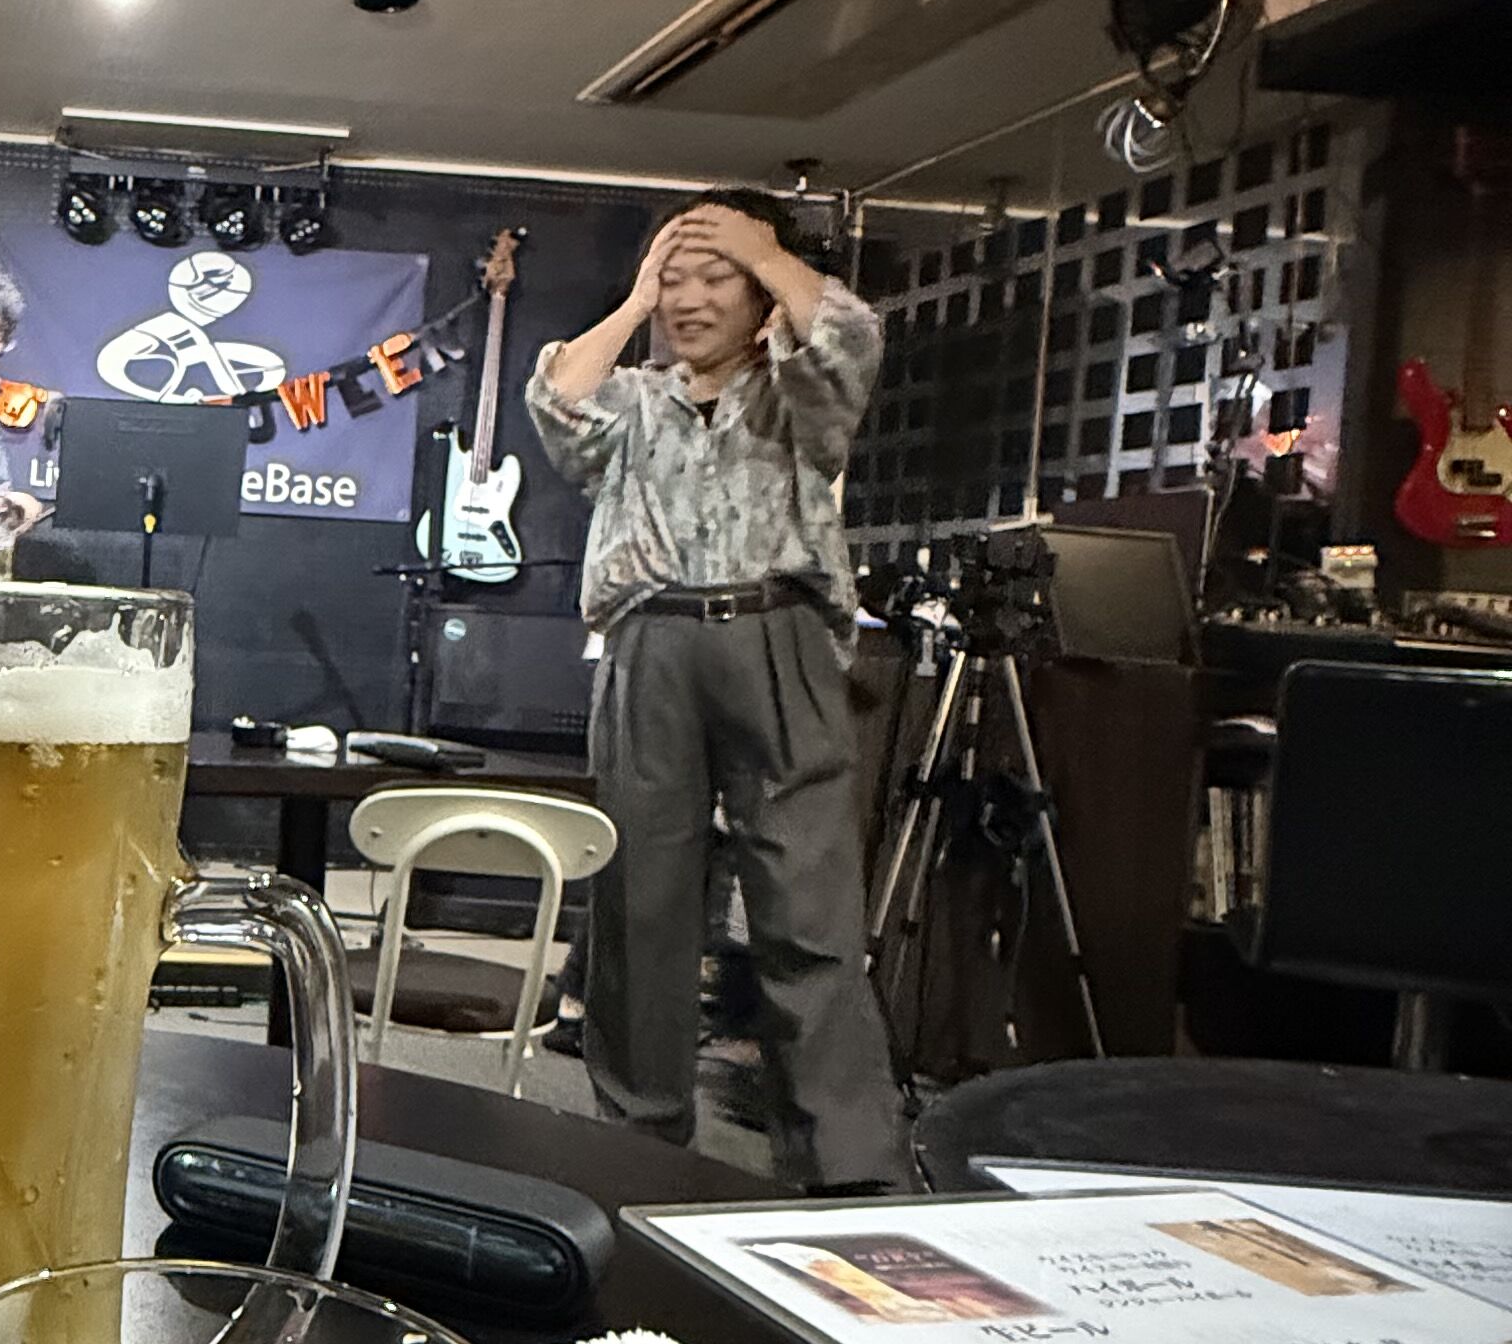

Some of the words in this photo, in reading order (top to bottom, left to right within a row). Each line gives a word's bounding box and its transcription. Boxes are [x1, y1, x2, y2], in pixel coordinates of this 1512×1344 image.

[241, 463, 357, 508] eBase
[981, 1320, 1110, 1343] 生ビール
